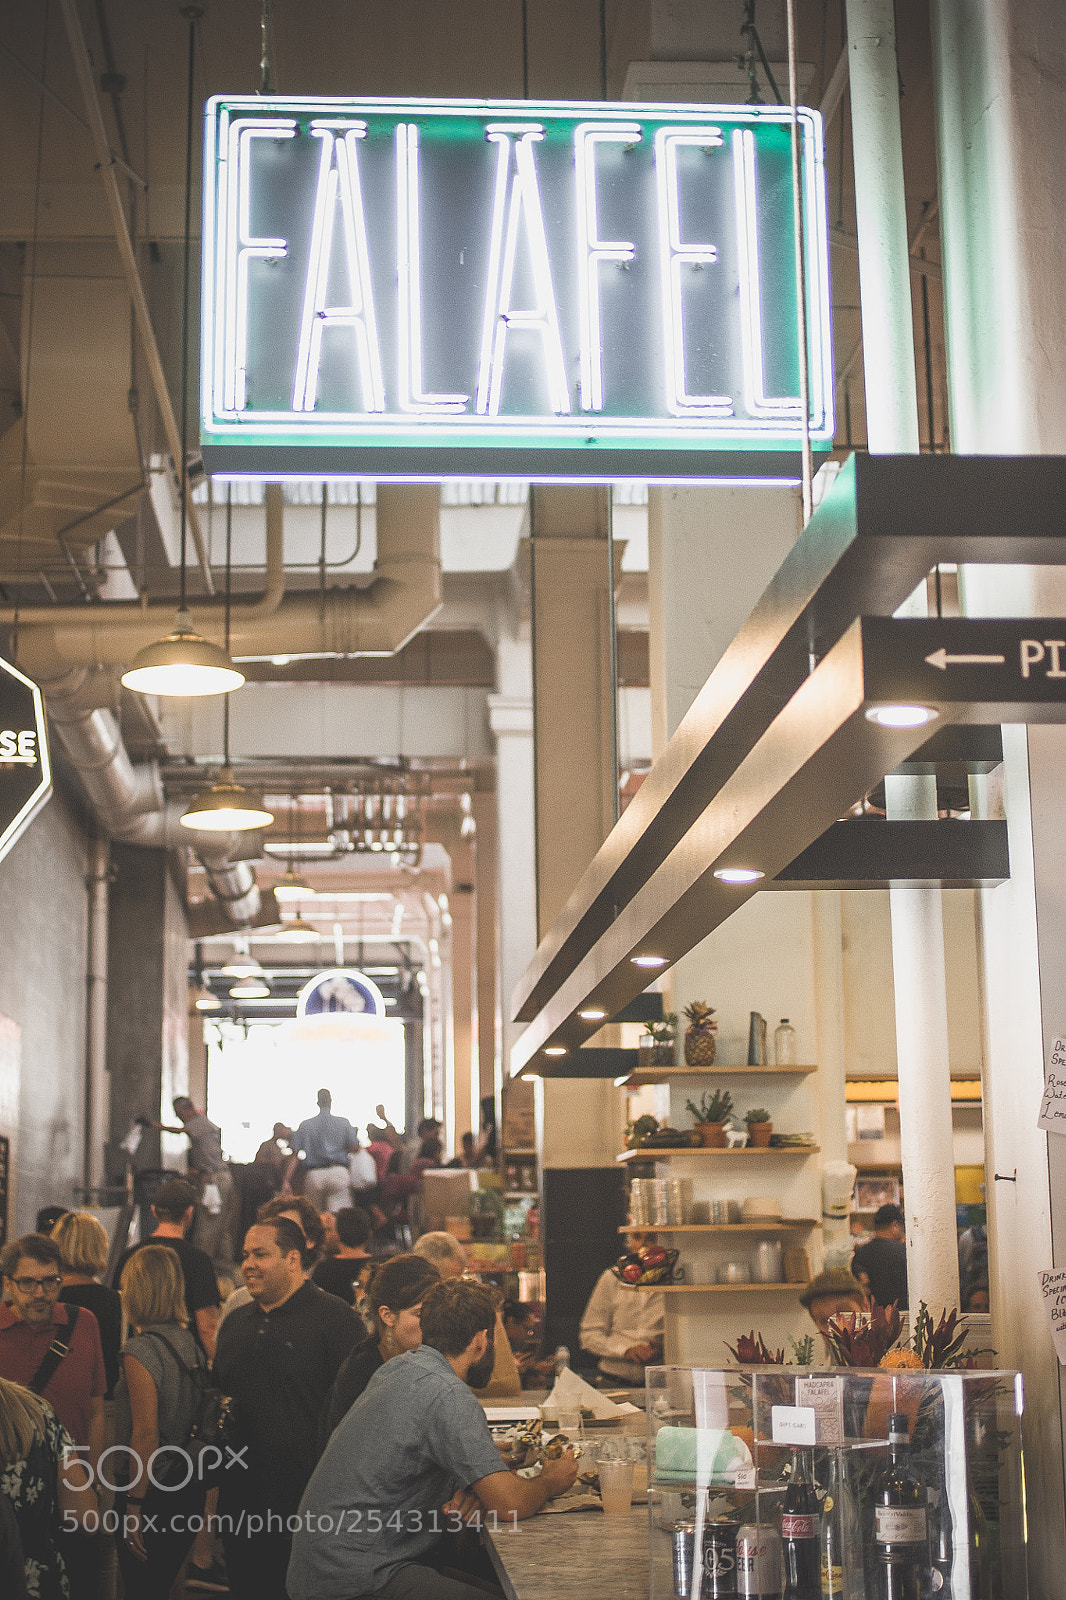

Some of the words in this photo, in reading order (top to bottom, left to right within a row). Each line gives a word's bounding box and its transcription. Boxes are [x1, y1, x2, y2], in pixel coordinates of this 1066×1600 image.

[227, 117, 806, 418] FALAFEL
[1019, 639, 1066, 678] PI
[0, 730, 36, 756] SE
